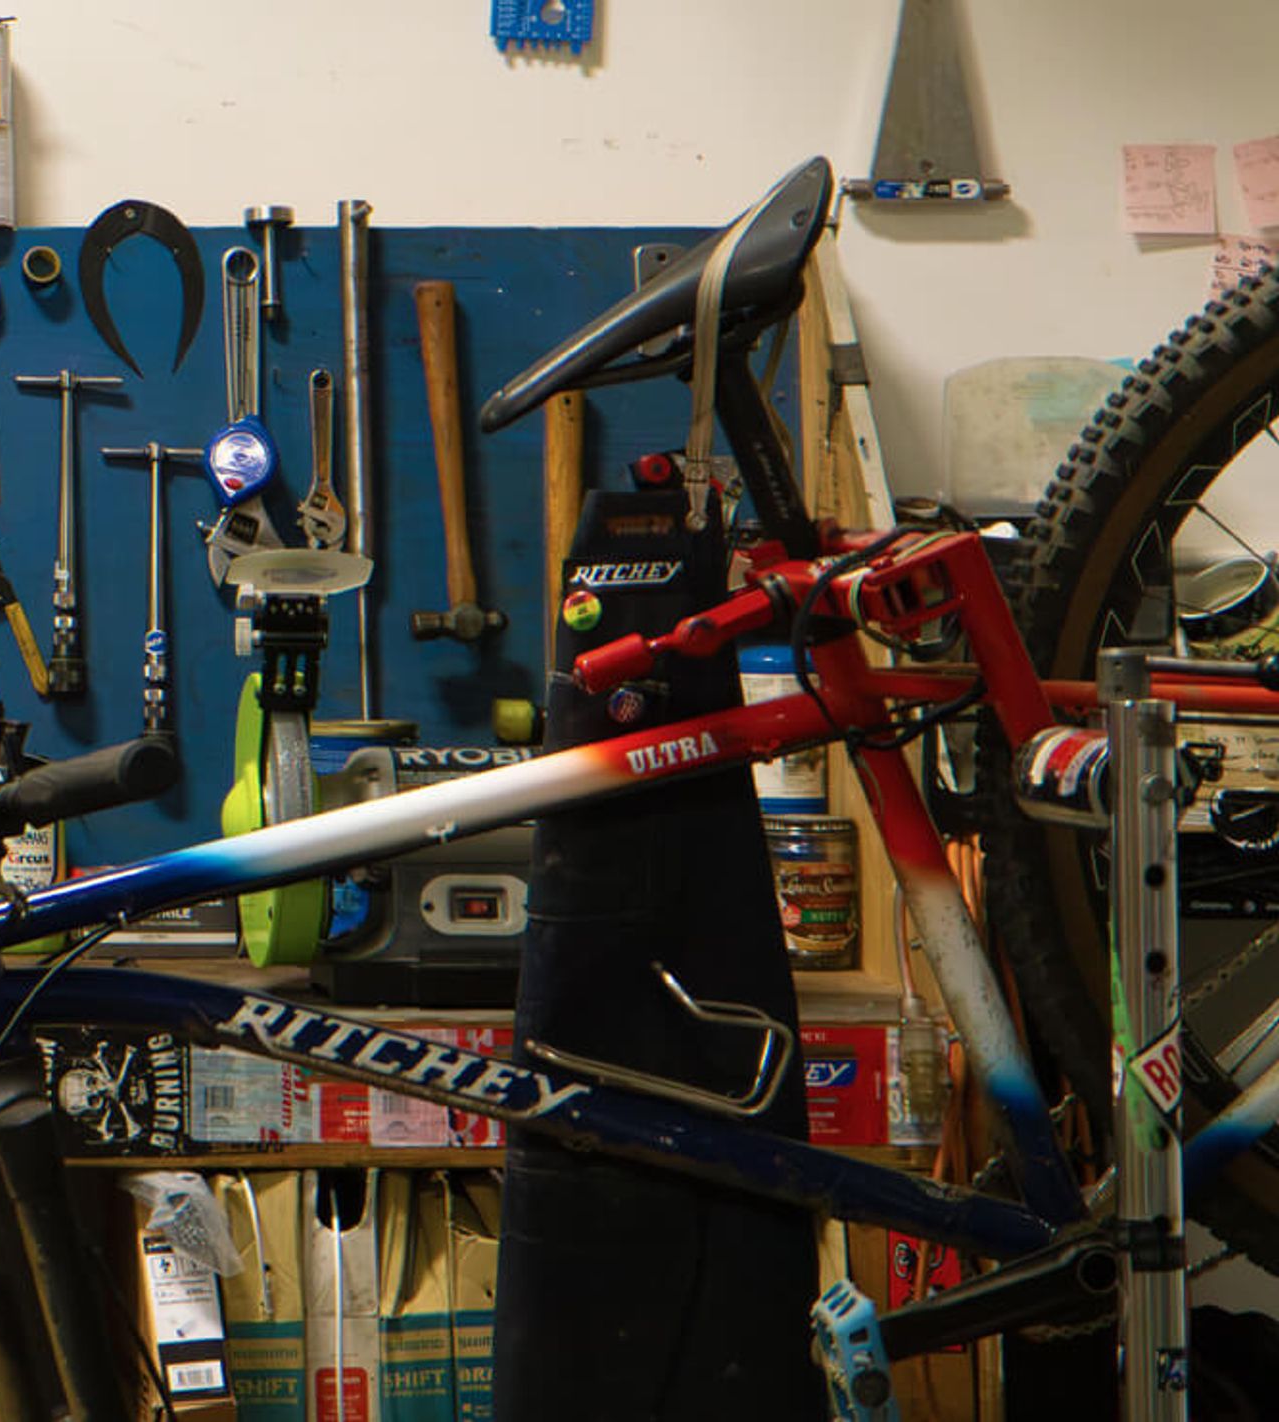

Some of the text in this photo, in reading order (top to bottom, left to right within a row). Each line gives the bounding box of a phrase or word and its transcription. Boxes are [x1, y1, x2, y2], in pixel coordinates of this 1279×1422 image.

[569, 560, 683, 587] RITCHEY
[398, 747, 532, 768] RYOBI
[626, 731, 719, 775] ULTRA
[216, 997, 590, 1120] RITCHEY
[148, 1032, 183, 1149] BURNING
[235, 1376, 299, 1396] SHIFT
[383, 1369, 446, 1390] SHIFT
